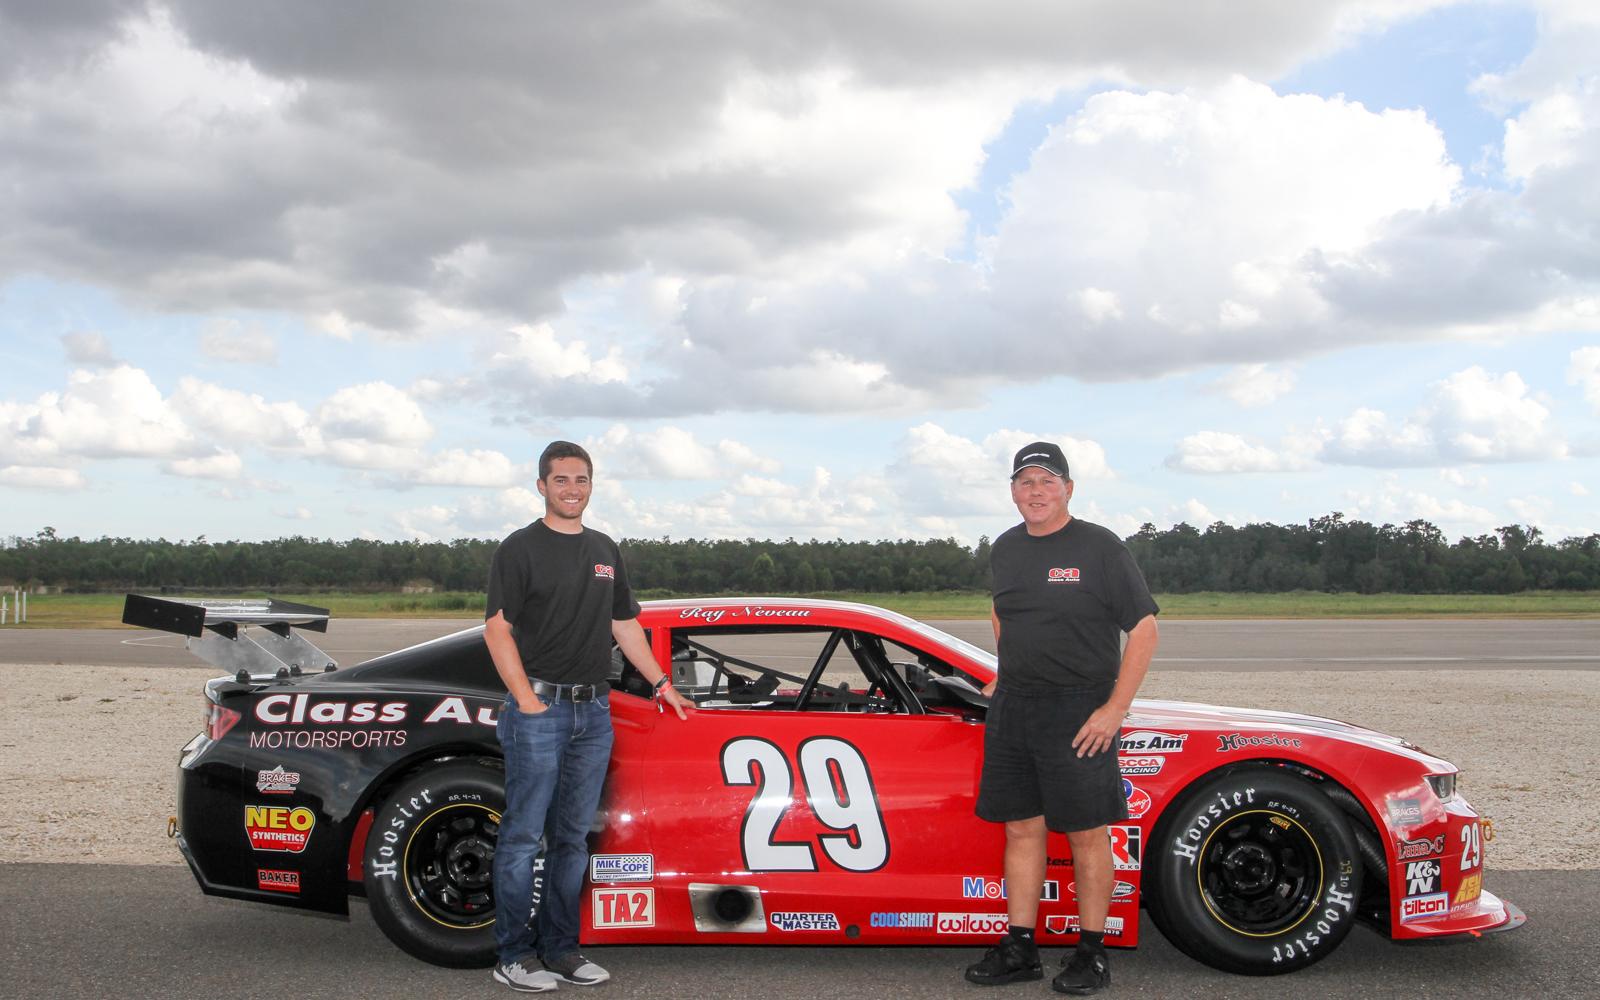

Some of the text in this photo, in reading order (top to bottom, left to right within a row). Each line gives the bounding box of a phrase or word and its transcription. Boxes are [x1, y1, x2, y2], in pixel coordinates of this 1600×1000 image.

[680, 606, 811, 623] Ray Neveau
[255, 694, 498, 726] Class Au
[249, 730, 408, 749] MOTORSPORTS
[1147, 736, 1182, 749] Am
[1216, 733, 1302, 752] Hoosier
[1118, 758, 1160, 767] SCCA
[260, 773, 300, 784] BRAKES
[719, 735, 890, 873] 29
[247, 807, 314, 831] NEO
[1173, 787, 1256, 865] Hoosier
[253, 831, 305, 842] SYNTHETICS
[372, 788, 432, 880] Hoosier
[1460, 822, 1480, 871] 29
[596, 860, 649, 872] MIKE COPE
[259, 871, 298, 882] BAKER
[599, 893, 648, 923] TA2
[1404, 898, 1445, 916] tilton
[772, 913, 835, 924] QUARTER
[783, 921, 839, 931] MASTER
[939, 914, 1009, 933] wilwo
[1272, 883, 1353, 963] Hoosier
